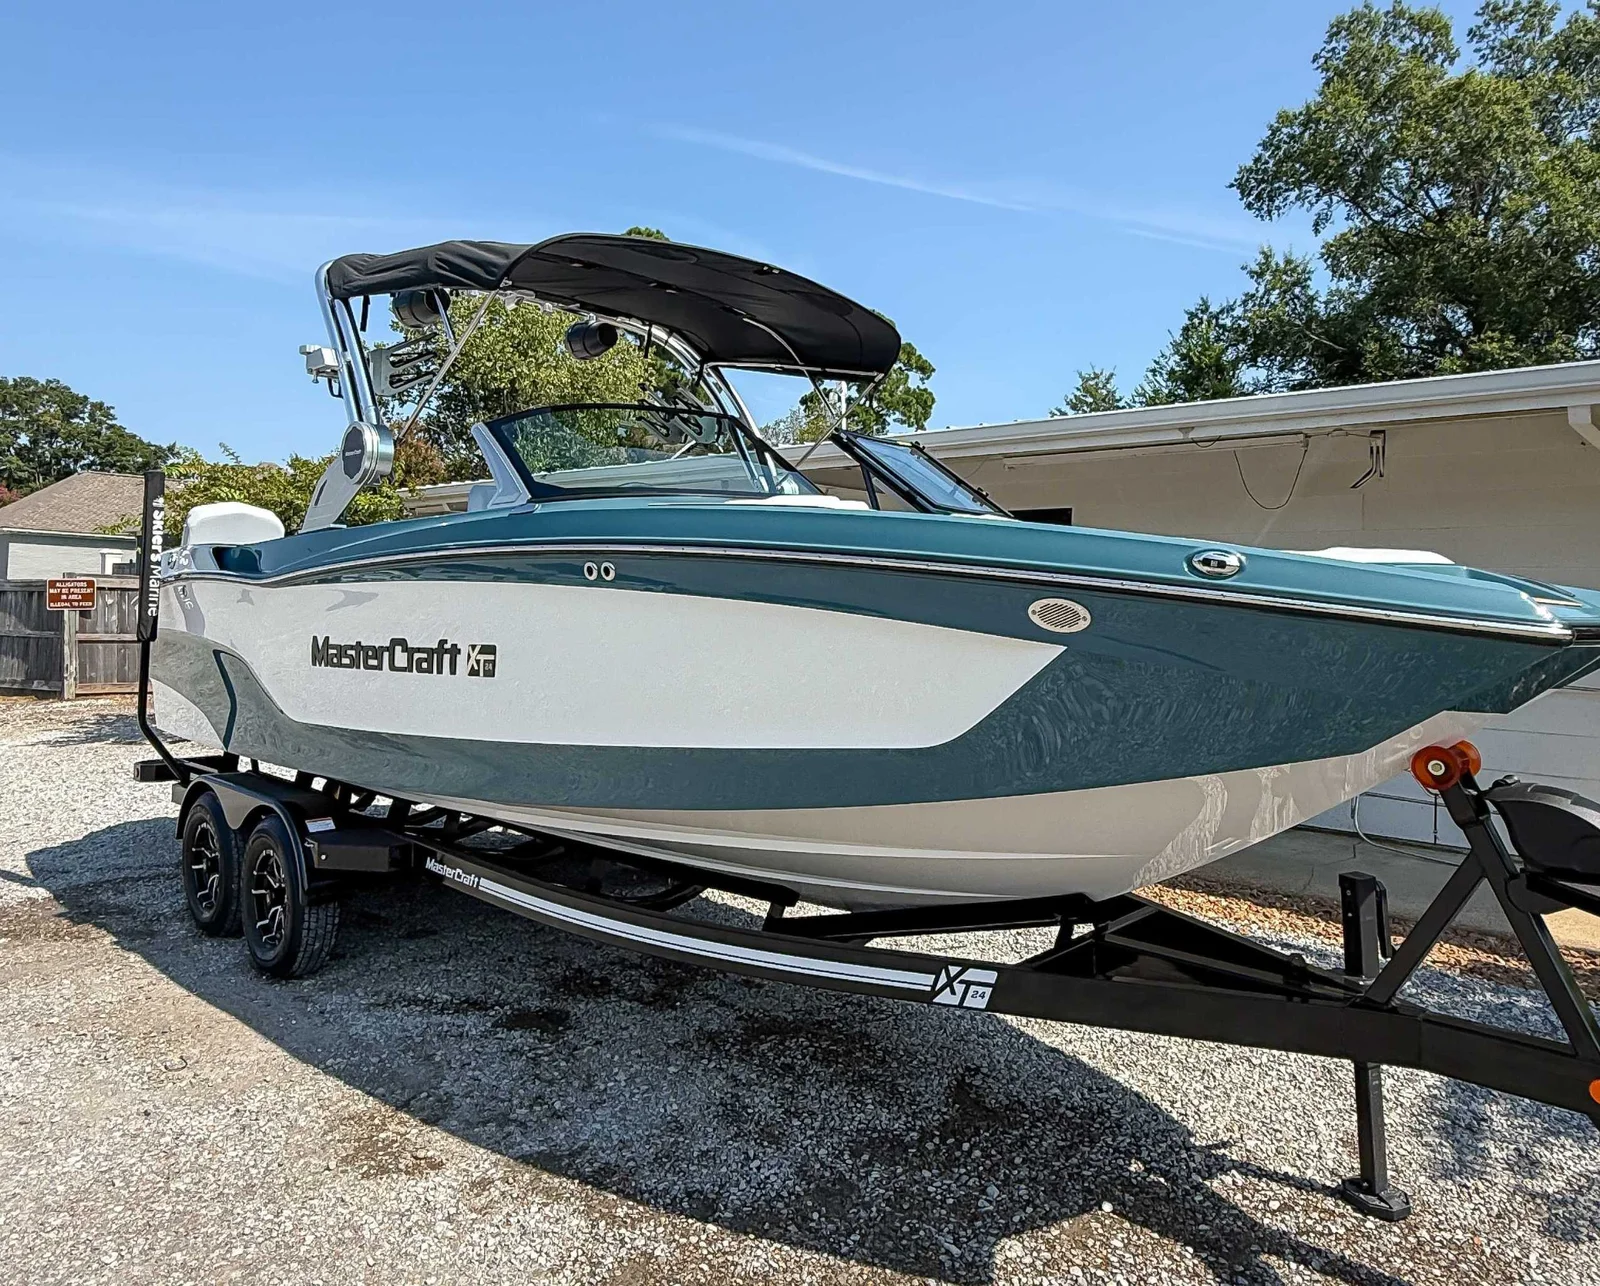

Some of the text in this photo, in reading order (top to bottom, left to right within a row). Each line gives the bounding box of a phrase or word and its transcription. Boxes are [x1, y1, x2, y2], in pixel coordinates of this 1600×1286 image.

[147, 510, 164, 617] Skiers Marine
[311, 635, 461, 675] MasterCraft
[425, 856, 478, 888] MasterCraft
[932, 963, 996, 1009] XT 24
